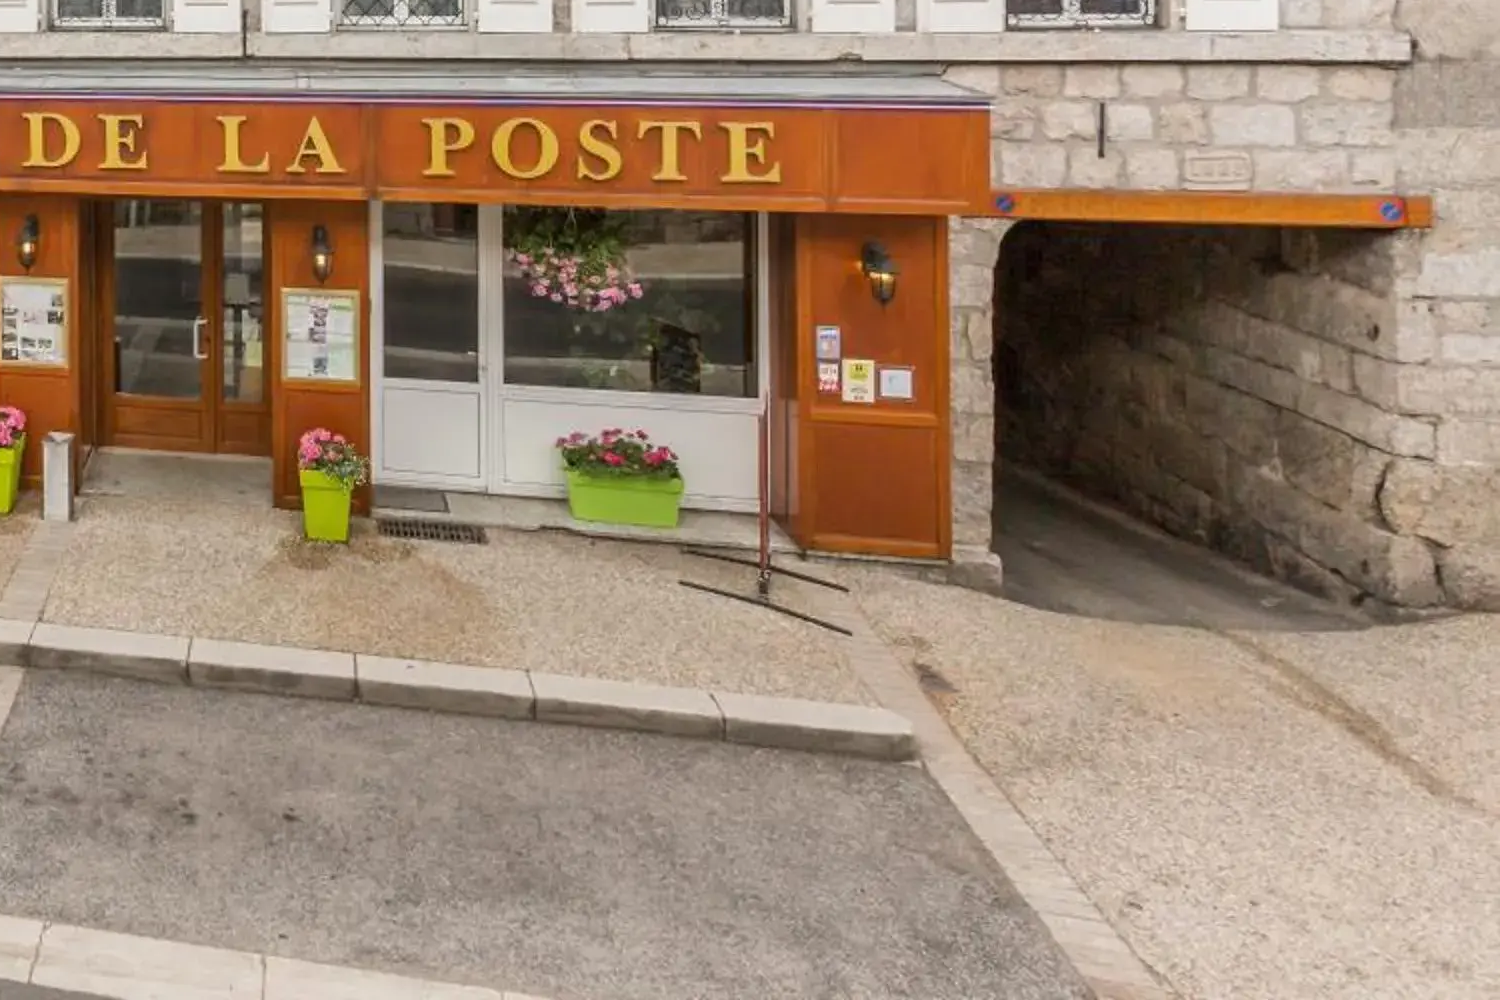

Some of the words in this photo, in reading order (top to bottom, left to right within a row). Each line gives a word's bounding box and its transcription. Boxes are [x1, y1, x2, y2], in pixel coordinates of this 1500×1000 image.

[20, 111, 148, 169] DE
[215, 115, 346, 173] LA
[421, 117, 782, 183] POSTE
